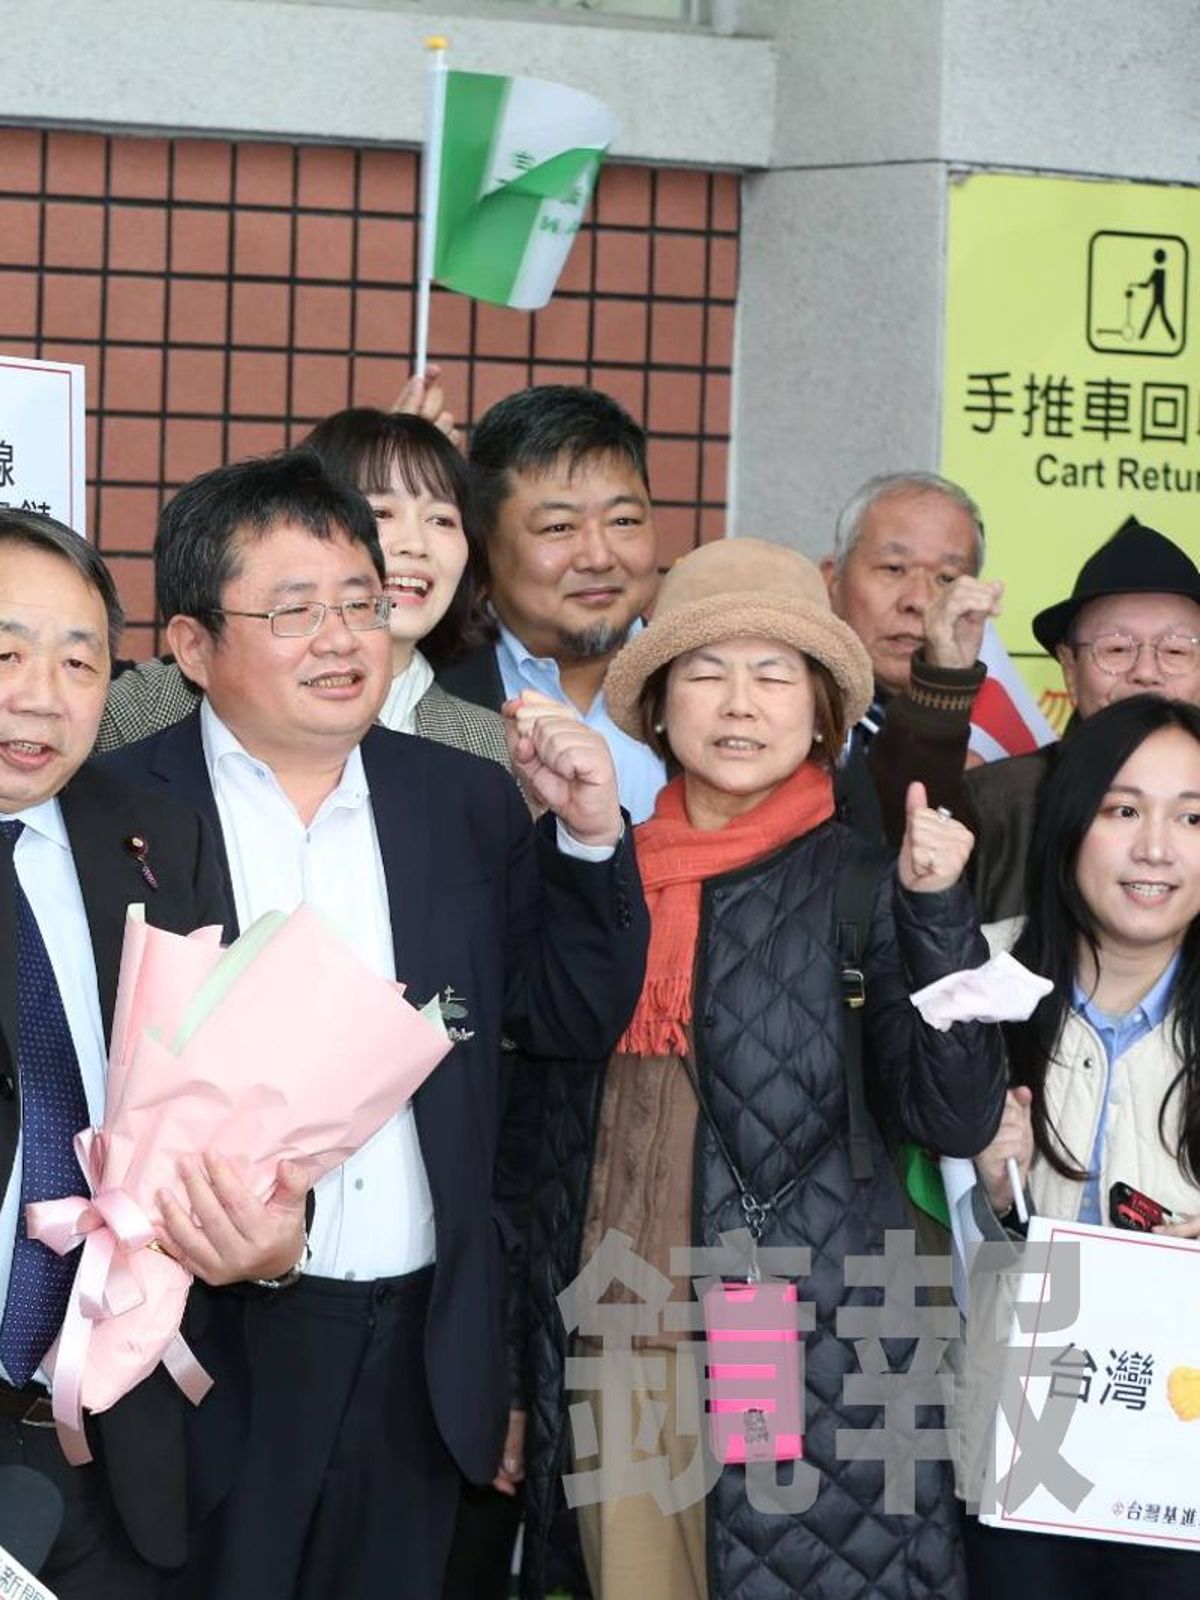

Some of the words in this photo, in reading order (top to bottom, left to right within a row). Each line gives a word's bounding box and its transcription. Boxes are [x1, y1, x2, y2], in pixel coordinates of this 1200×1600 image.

[964, 372, 1200, 445] 手推車回
[1036, 454, 1105, 488] Cart
[1050, 1342, 1154, 1411] 台灣
[1127, 1500, 1200, 1526] 台灣基進
